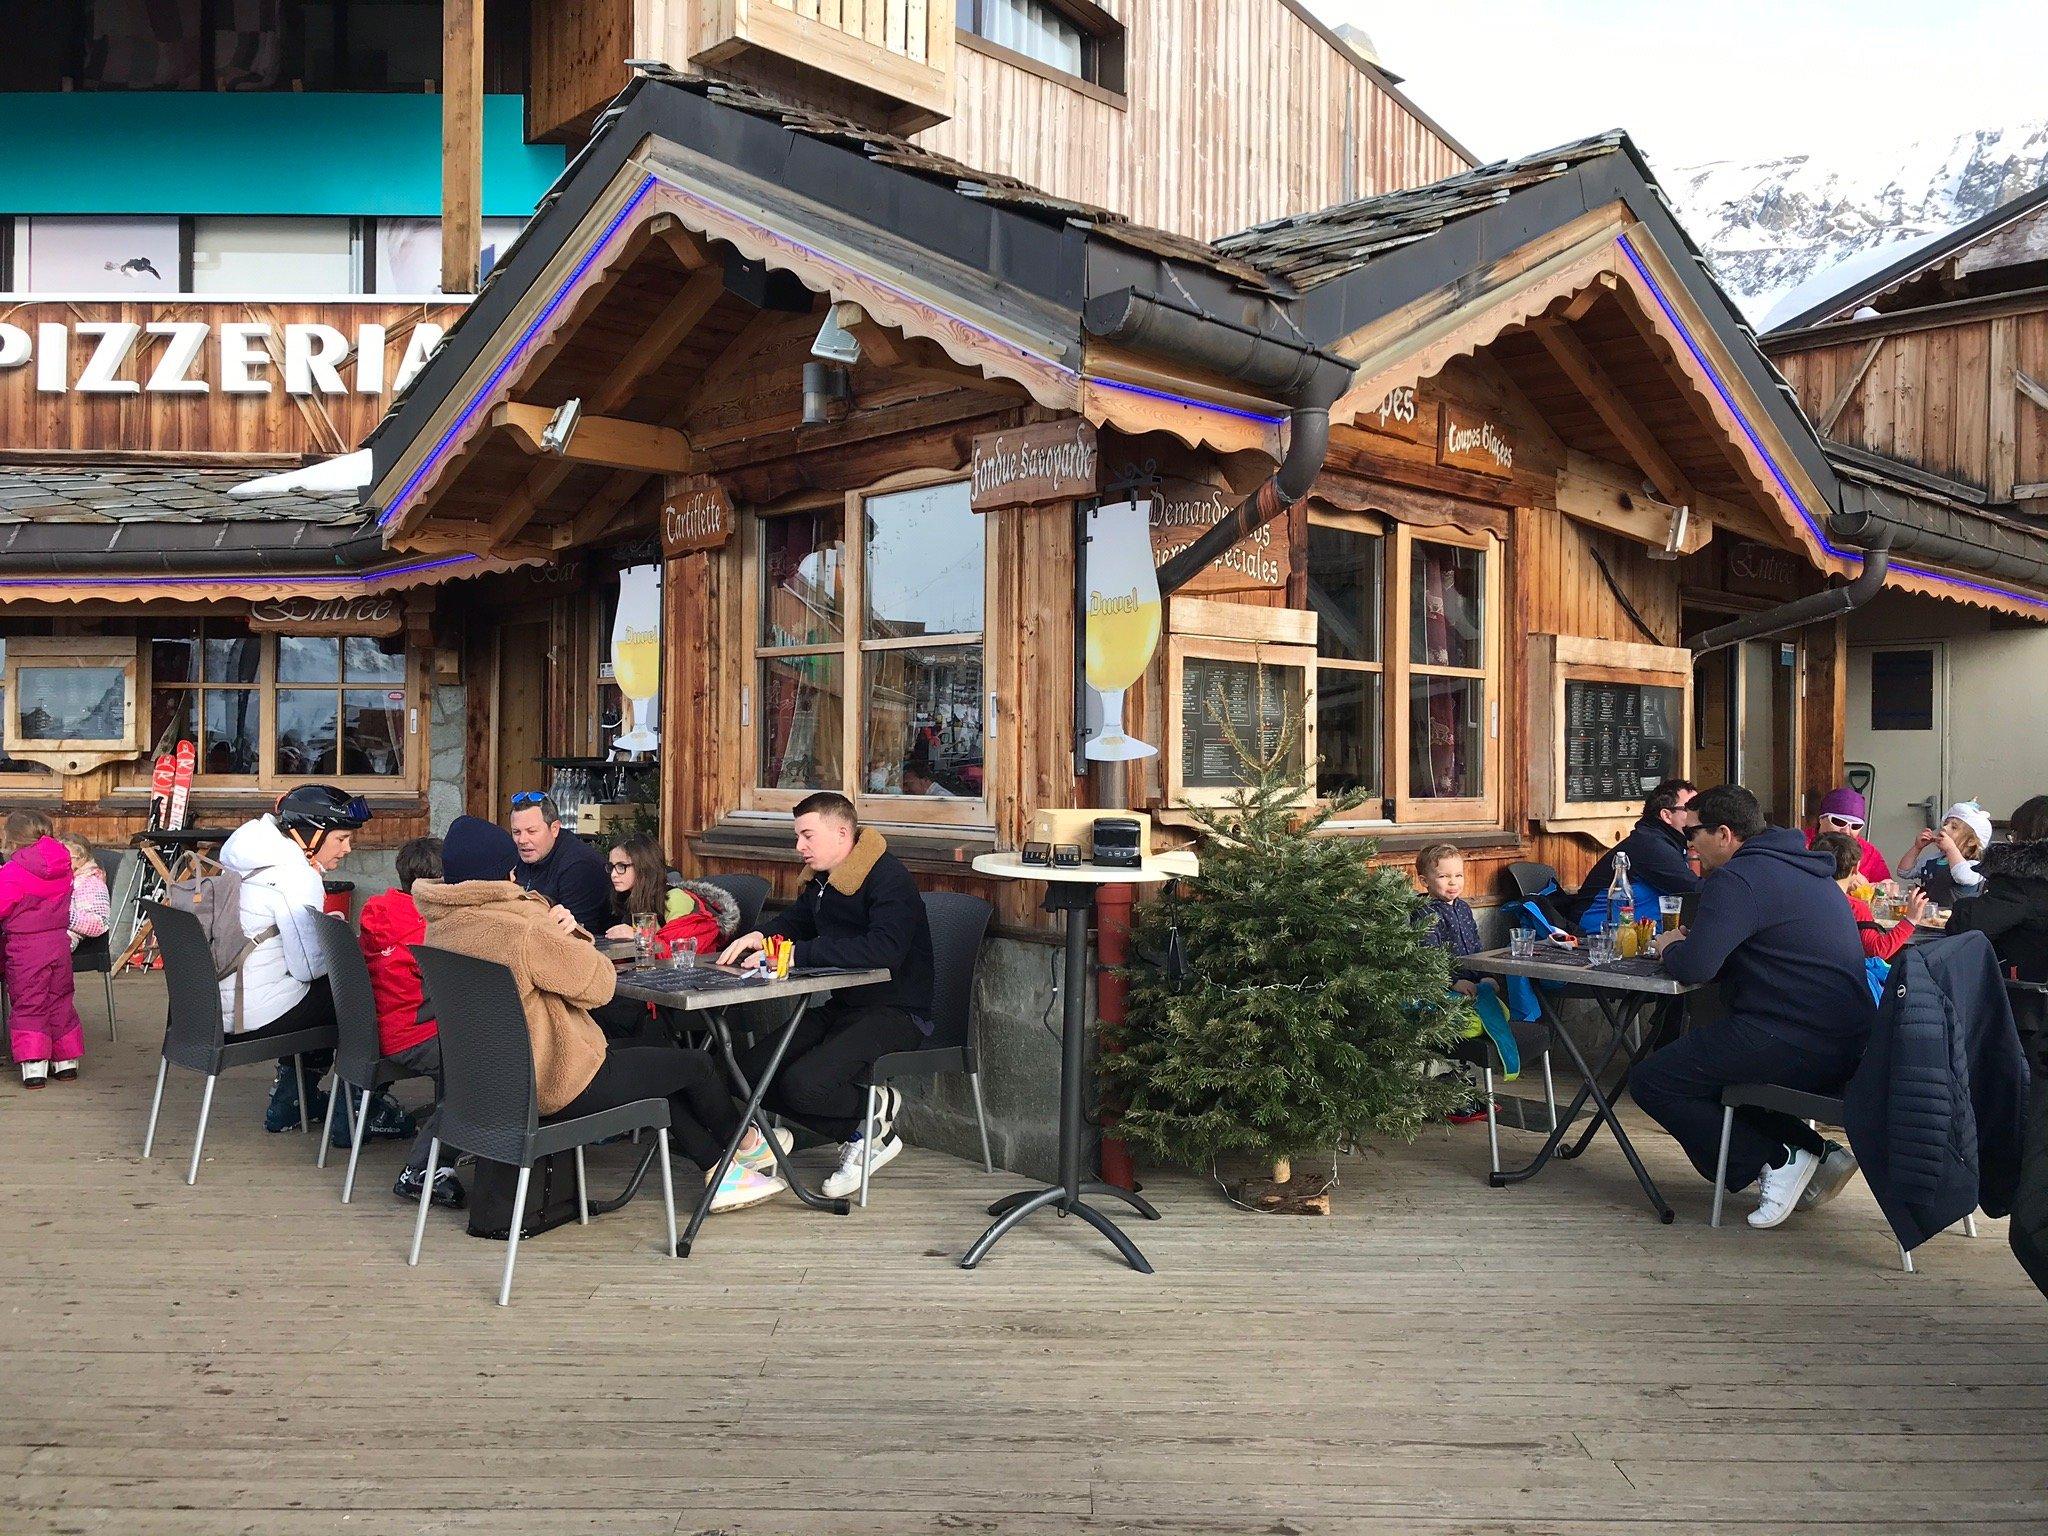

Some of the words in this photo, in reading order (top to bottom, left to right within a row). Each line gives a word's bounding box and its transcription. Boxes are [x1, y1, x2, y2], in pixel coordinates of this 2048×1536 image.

[1372, 387, 1415, 428] pes
[1448, 421, 1481, 456] Coupes
[665, 492, 721, 545] Tartiflette
[1149, 488, 1236, 528] Demande
[1089, 586, 1139, 617] Duvel
[624, 624, 659, 645] Duvel
